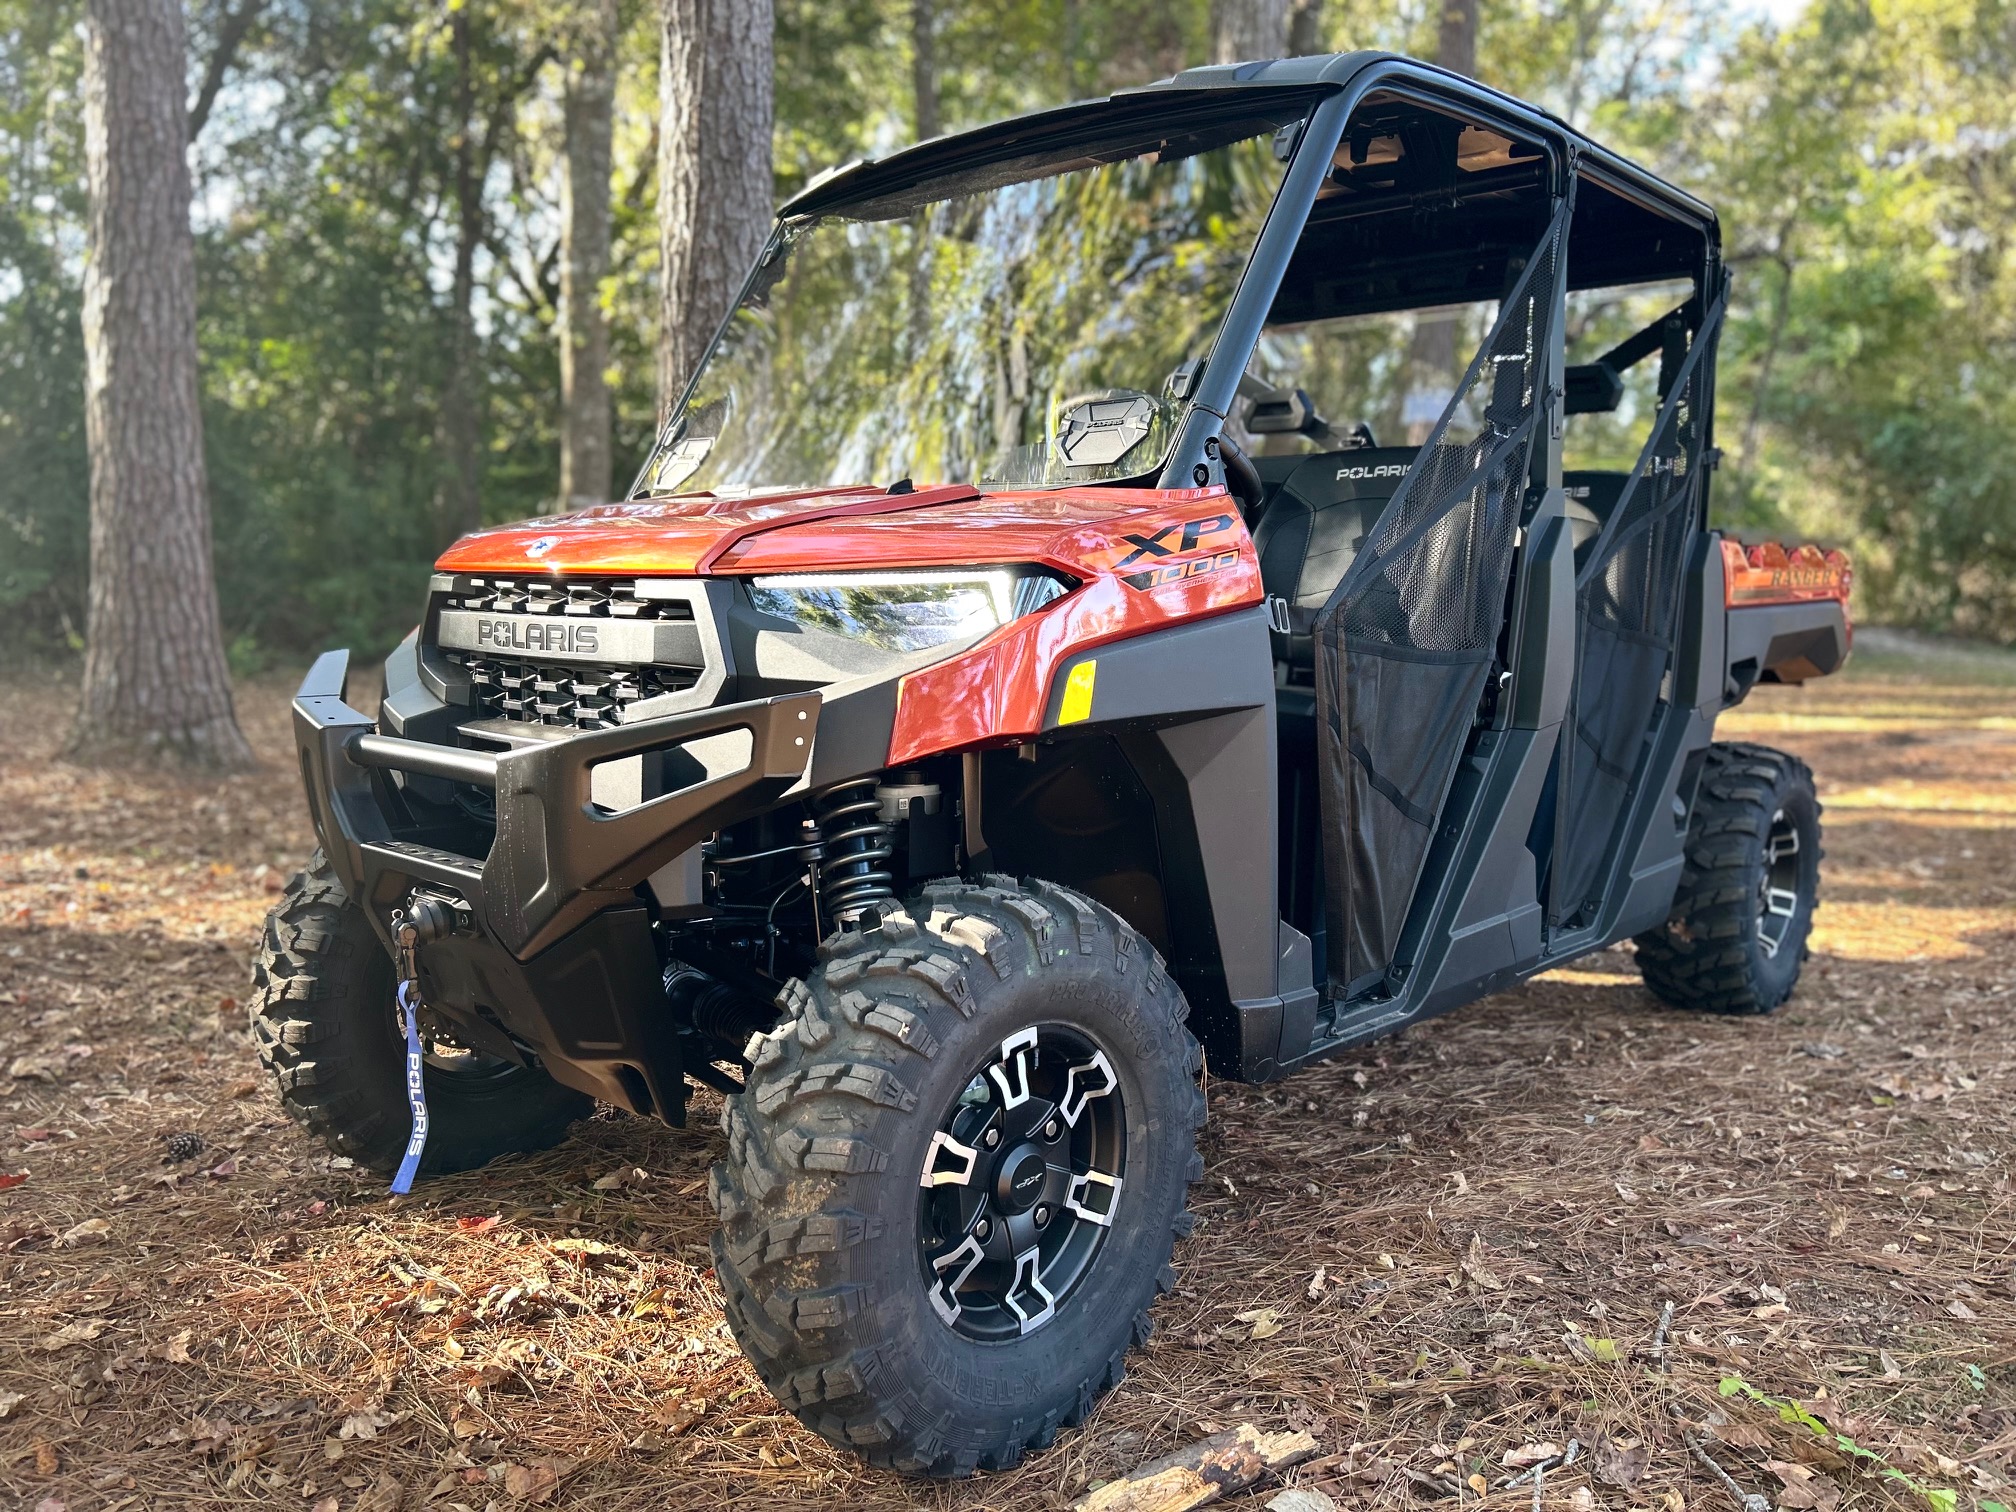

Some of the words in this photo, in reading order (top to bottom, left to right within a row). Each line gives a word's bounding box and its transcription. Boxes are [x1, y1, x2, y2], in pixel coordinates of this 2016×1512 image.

[1110, 513, 1236, 569] XP
[1149, 550, 1240, 587] 1000
[1771, 567, 1832, 587] RANGER
[477, 619, 600, 654] POLARIS
[408, 1053, 426, 1156] POLARIS
